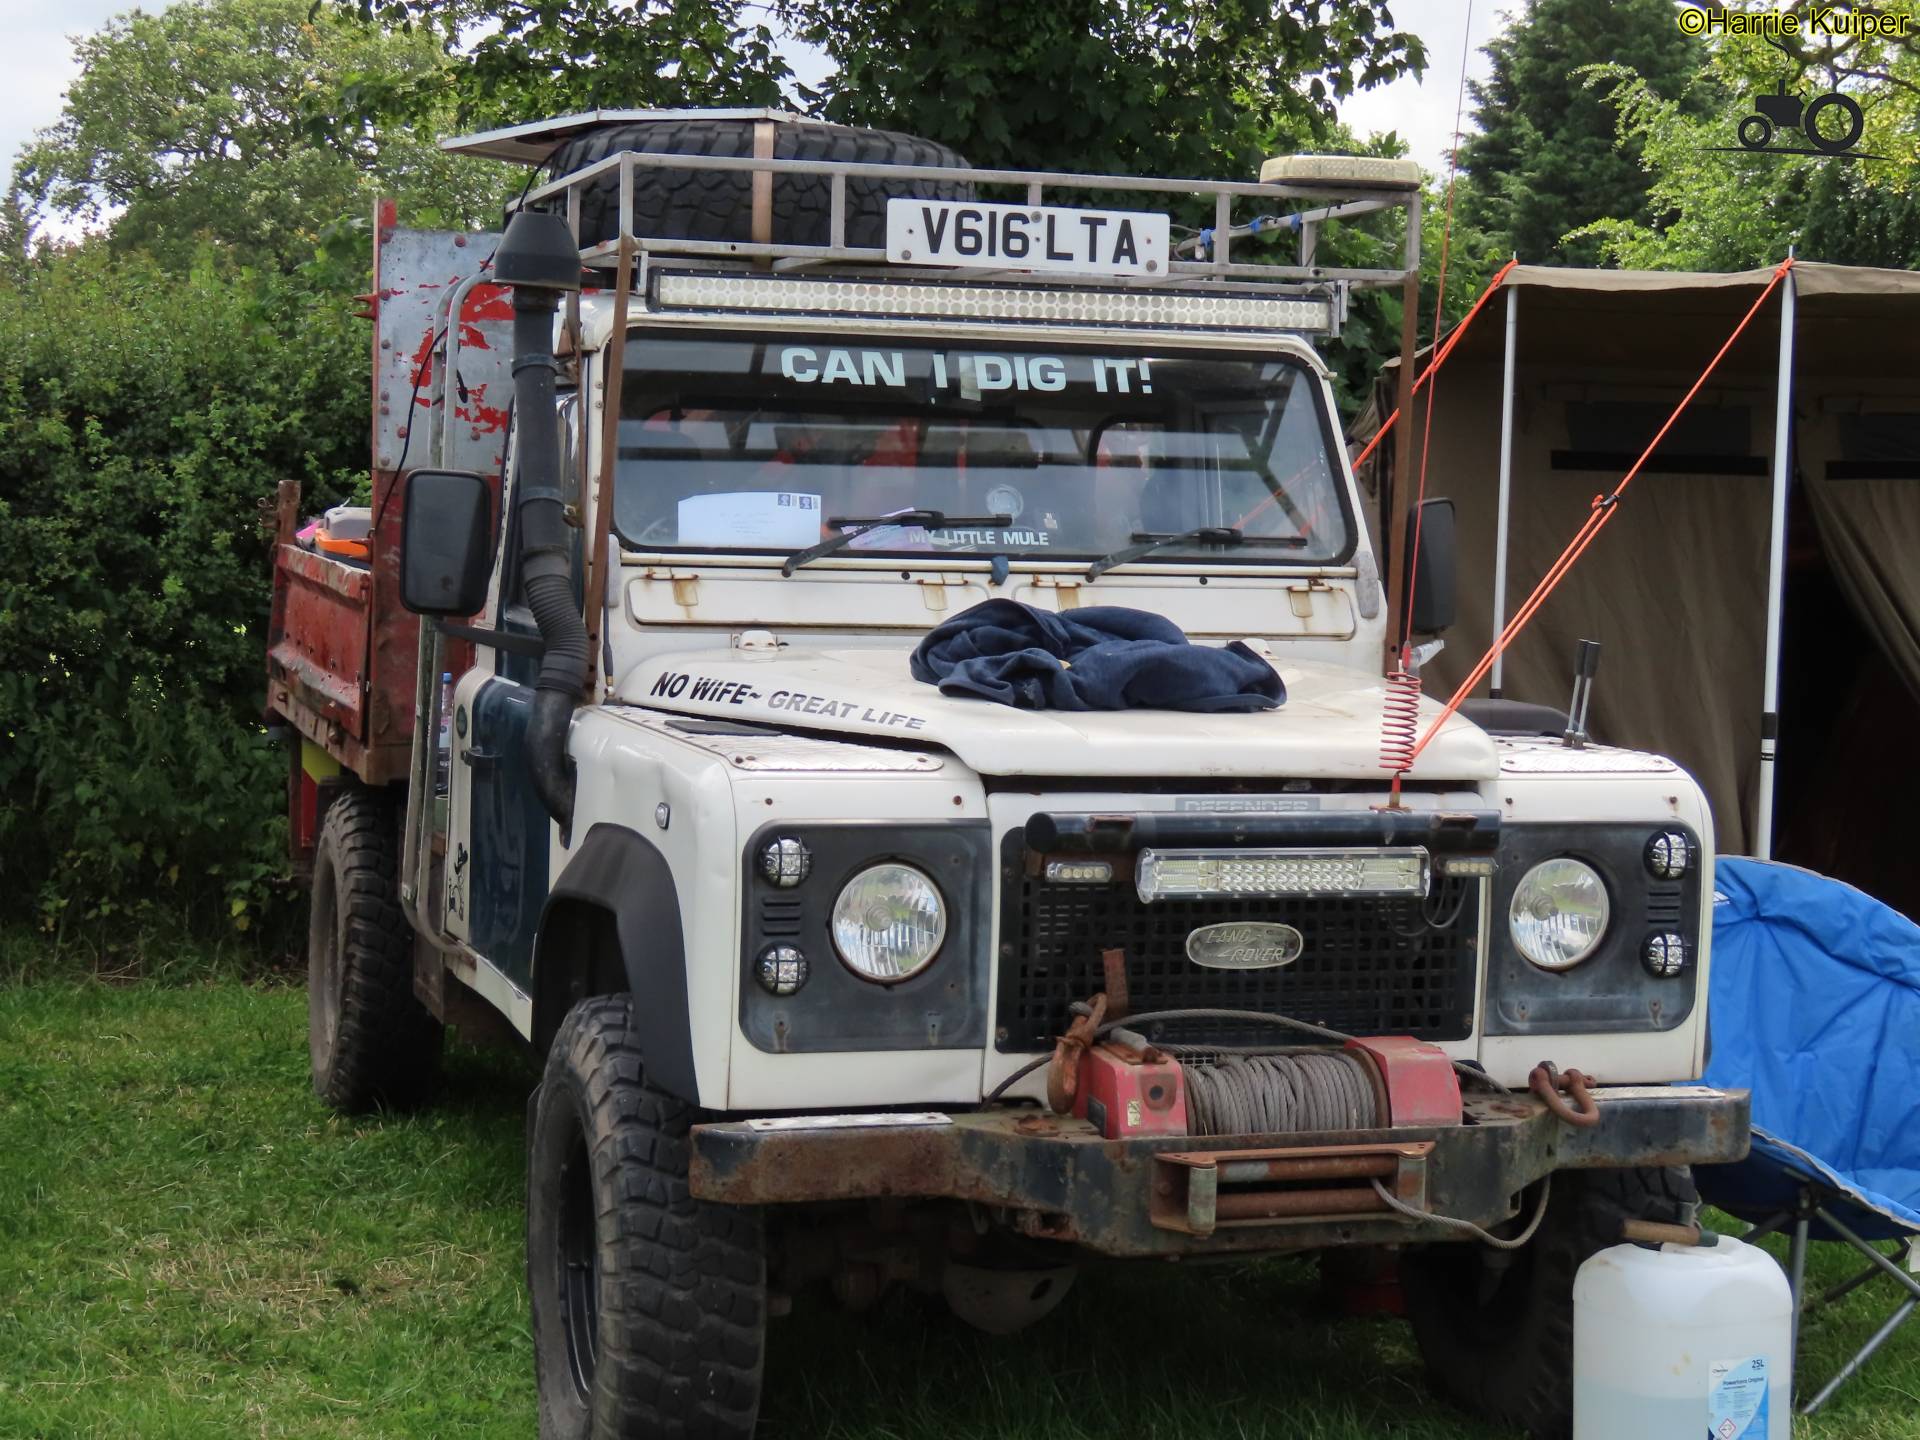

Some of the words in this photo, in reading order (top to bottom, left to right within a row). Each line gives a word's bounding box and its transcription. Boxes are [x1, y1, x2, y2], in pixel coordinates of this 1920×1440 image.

[922, 207, 1029, 258] V616
[1046, 214, 1138, 265] LTA
[781, 347, 906, 387] CAN
[933, 354, 948, 388] I
[973, 355, 1066, 391] DIG
[1092, 357, 1153, 394] IT!
[944, 531, 996, 545] LITTLE
[1003, 532, 1049, 546] MULE
[650, 671, 690, 698] NO
[767, 690, 859, 718] GREAT
[861, 708, 927, 730] LIFE
[1229, 948, 1285, 962] ROVER
[1751, 1359, 1765, 1369] 25L
